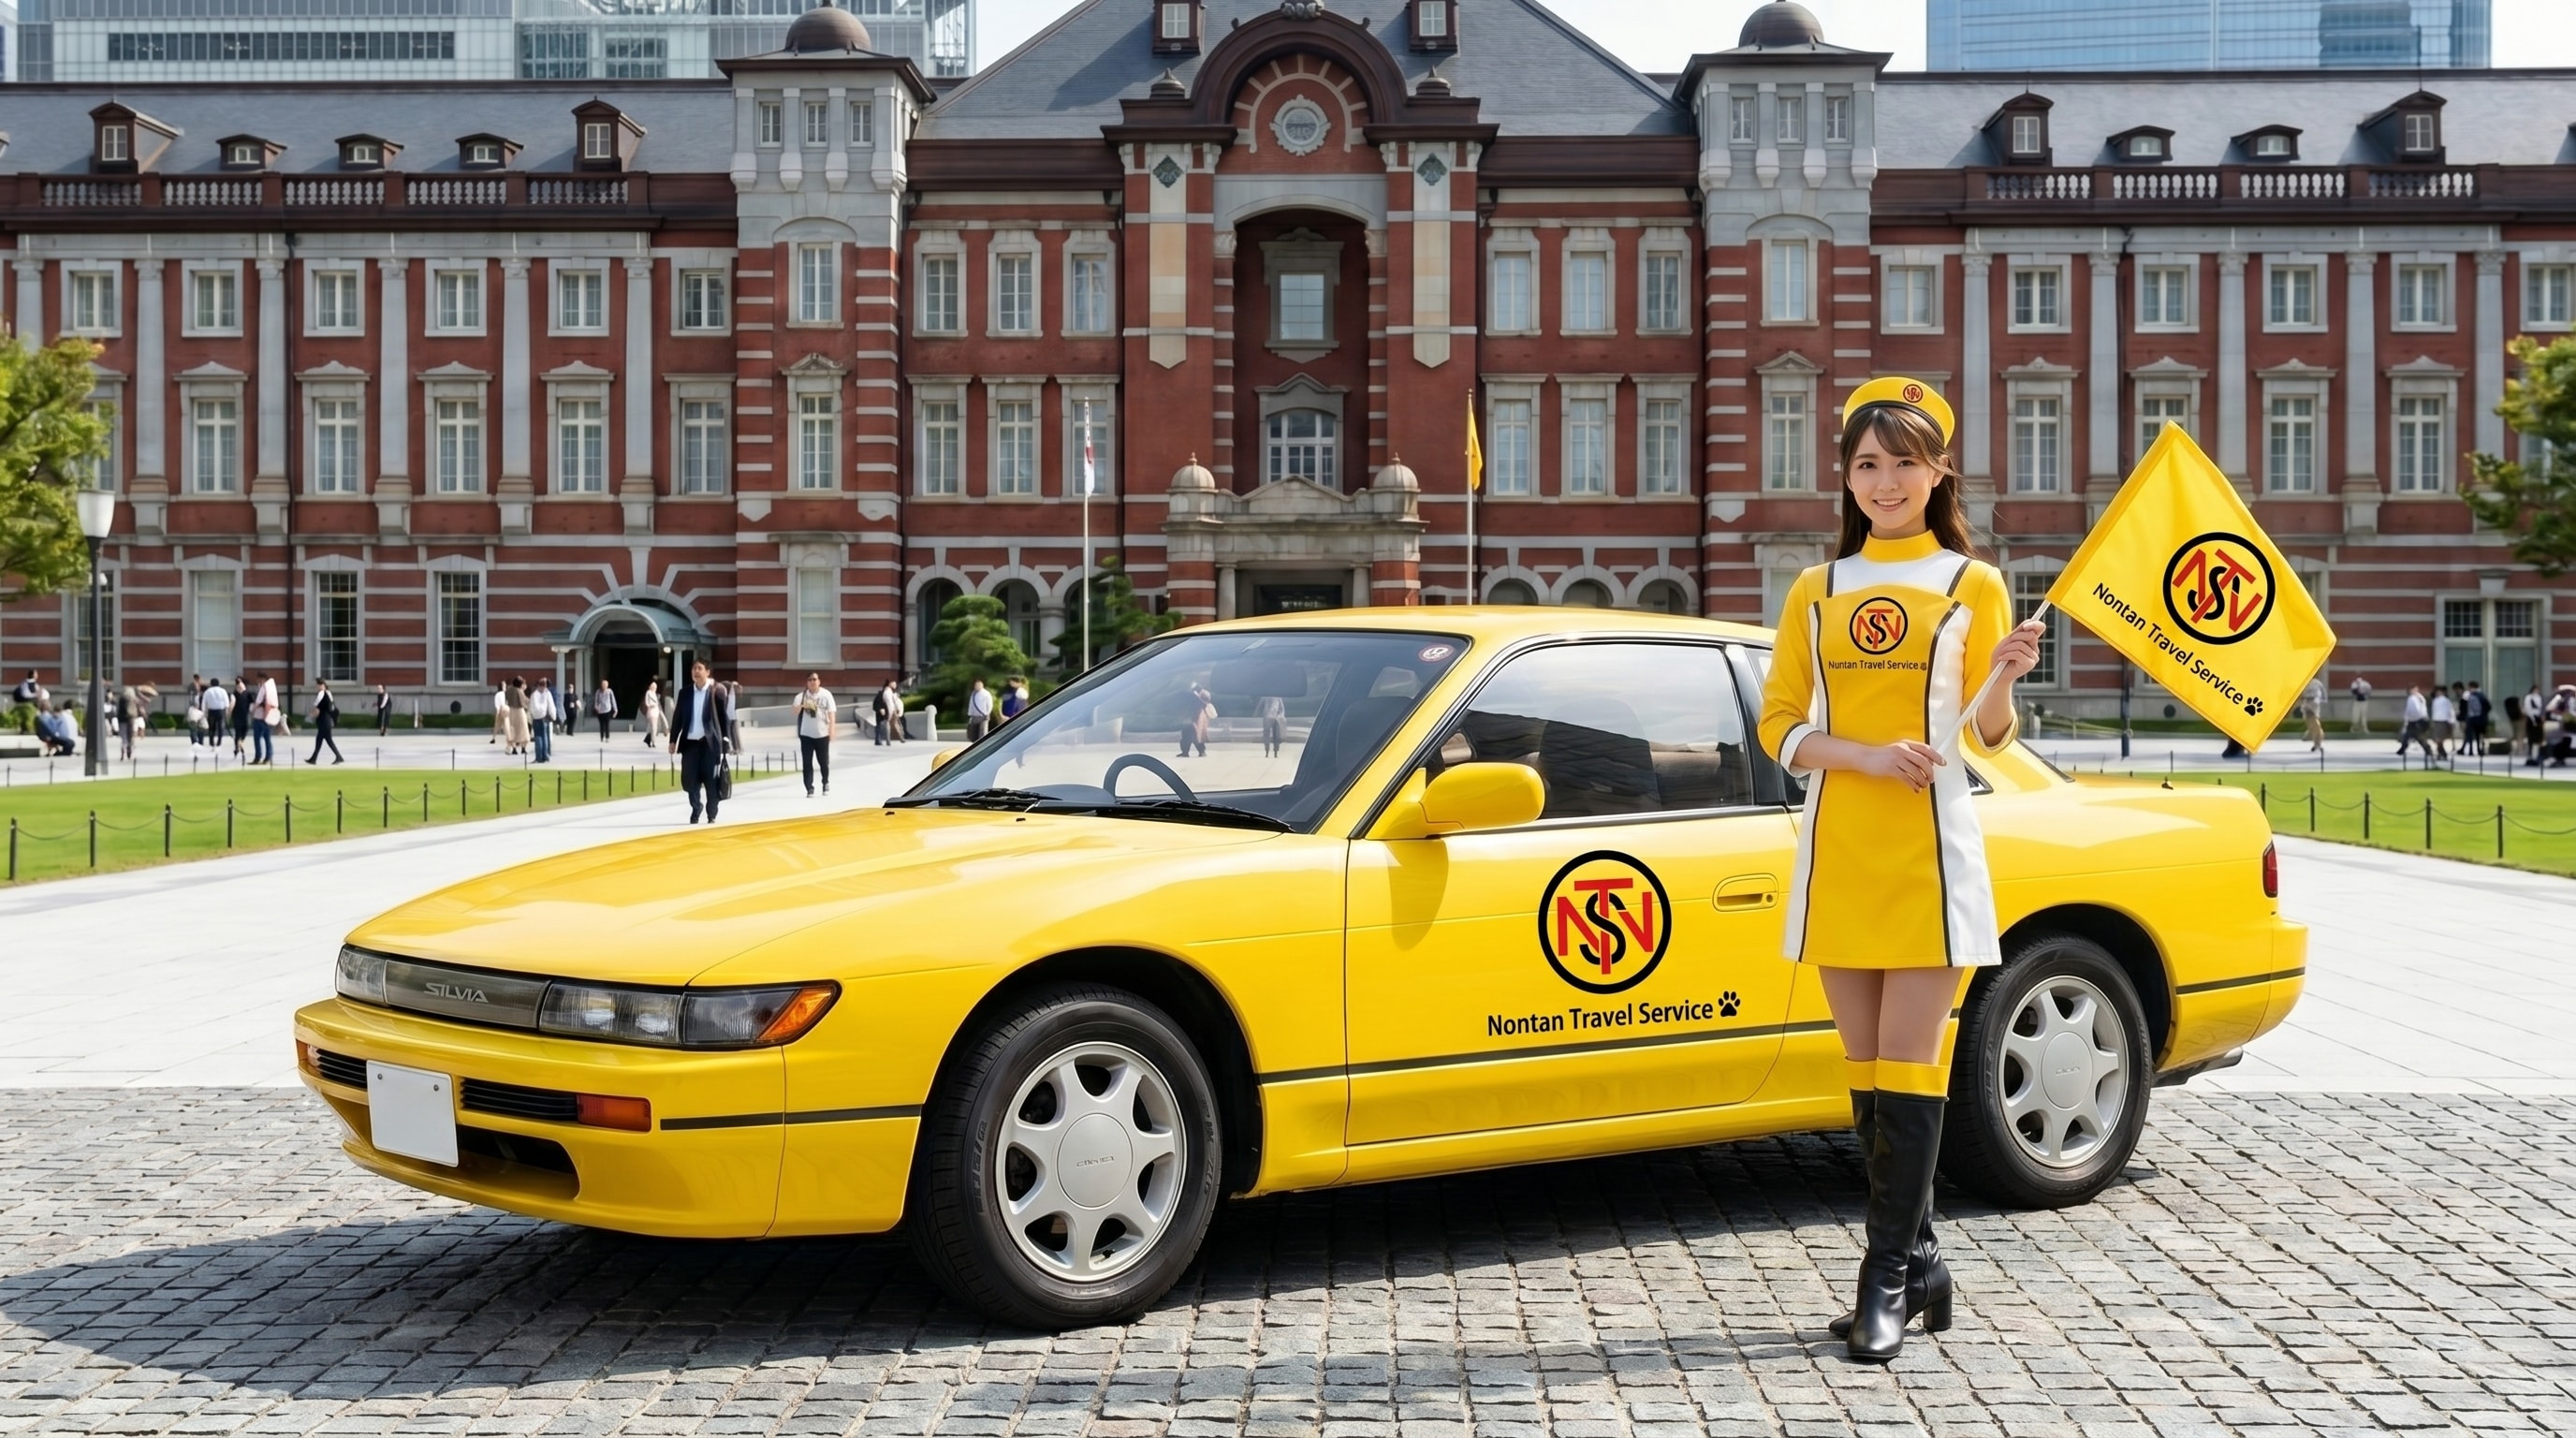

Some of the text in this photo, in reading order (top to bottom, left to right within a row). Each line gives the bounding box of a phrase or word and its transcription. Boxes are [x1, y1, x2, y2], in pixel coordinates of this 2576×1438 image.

[2092, 582, 2244, 705] Nontan Travel Service
[1859, 659, 1885, 669] Travel
[1886, 659, 1919, 670] Service
[423, 982, 489, 1004] SILVIA
[1487, 1000, 1714, 1036] Nontan Travel Service
